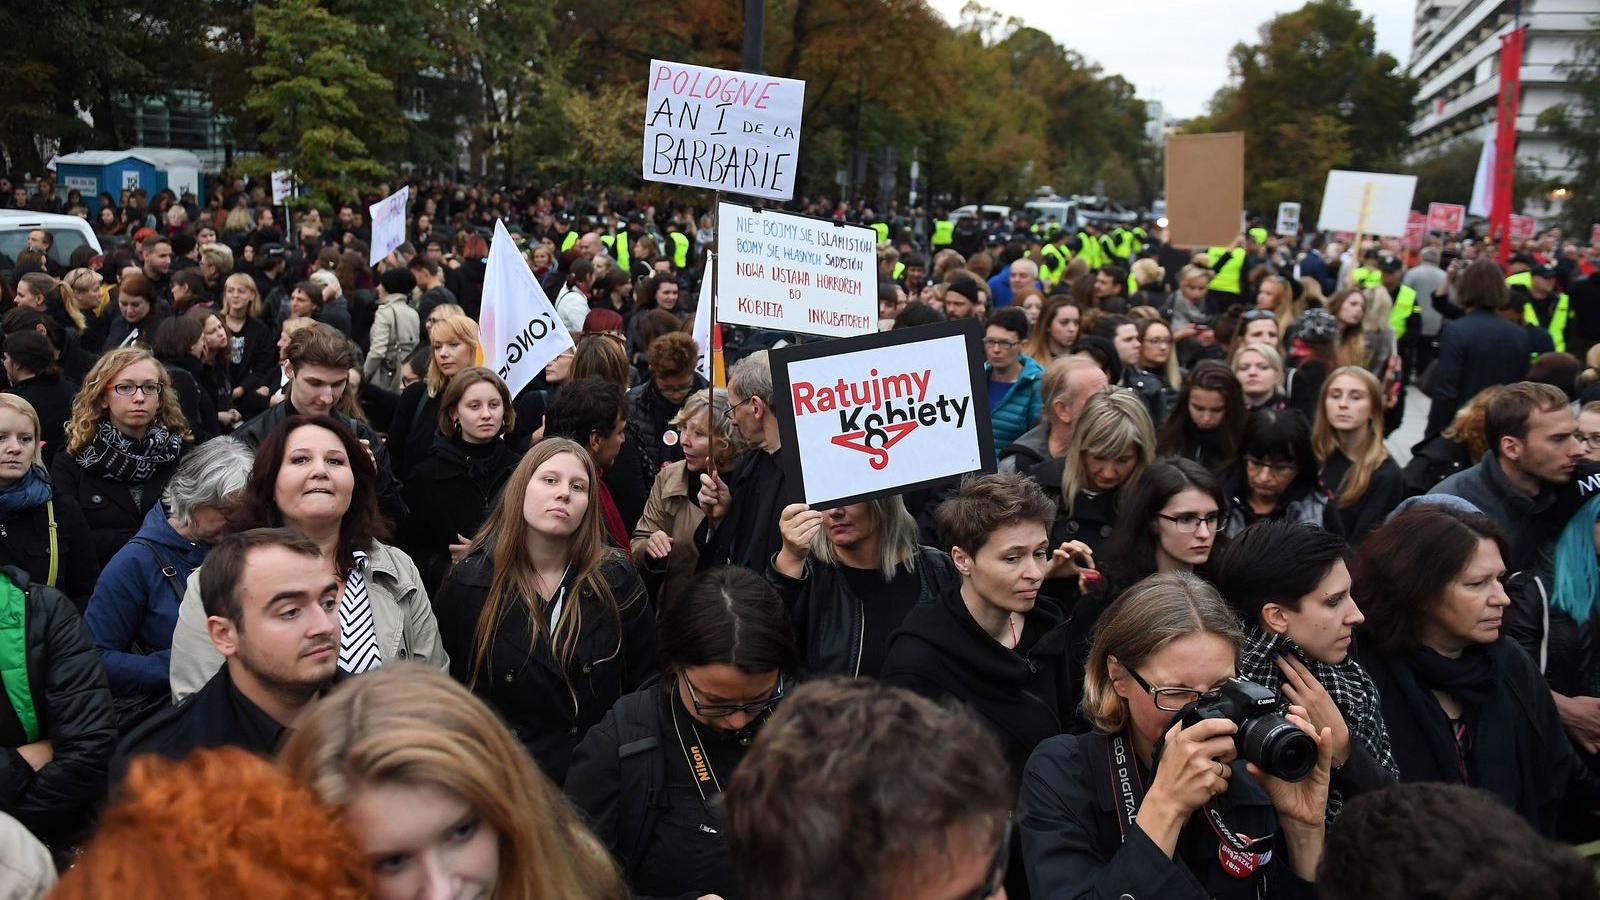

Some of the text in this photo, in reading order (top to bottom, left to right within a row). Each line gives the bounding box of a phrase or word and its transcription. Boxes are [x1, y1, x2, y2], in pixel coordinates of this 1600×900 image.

[653, 66, 780, 109] POLOGNE
[743, 120, 766, 133] DE
[773, 126, 794, 139] LA
[652, 133, 791, 191] BARBARIE
[767, 244, 780, 261] SIĘ
[799, 228, 814, 246] SIĘ
[736, 261, 861, 297] NOWA USTAWA HORROREM
[789, 289, 801, 299] BO
[738, 297, 870, 329] KOBIETA INKUBATOREM
[792, 368, 931, 416] Ratujmy
[839, 394, 969, 449] Kobiety
[691, 745, 710, 782] Nikon
[1113, 736, 1137, 825] EOS DIGITAL
[1210, 809, 1245, 849] Canon
